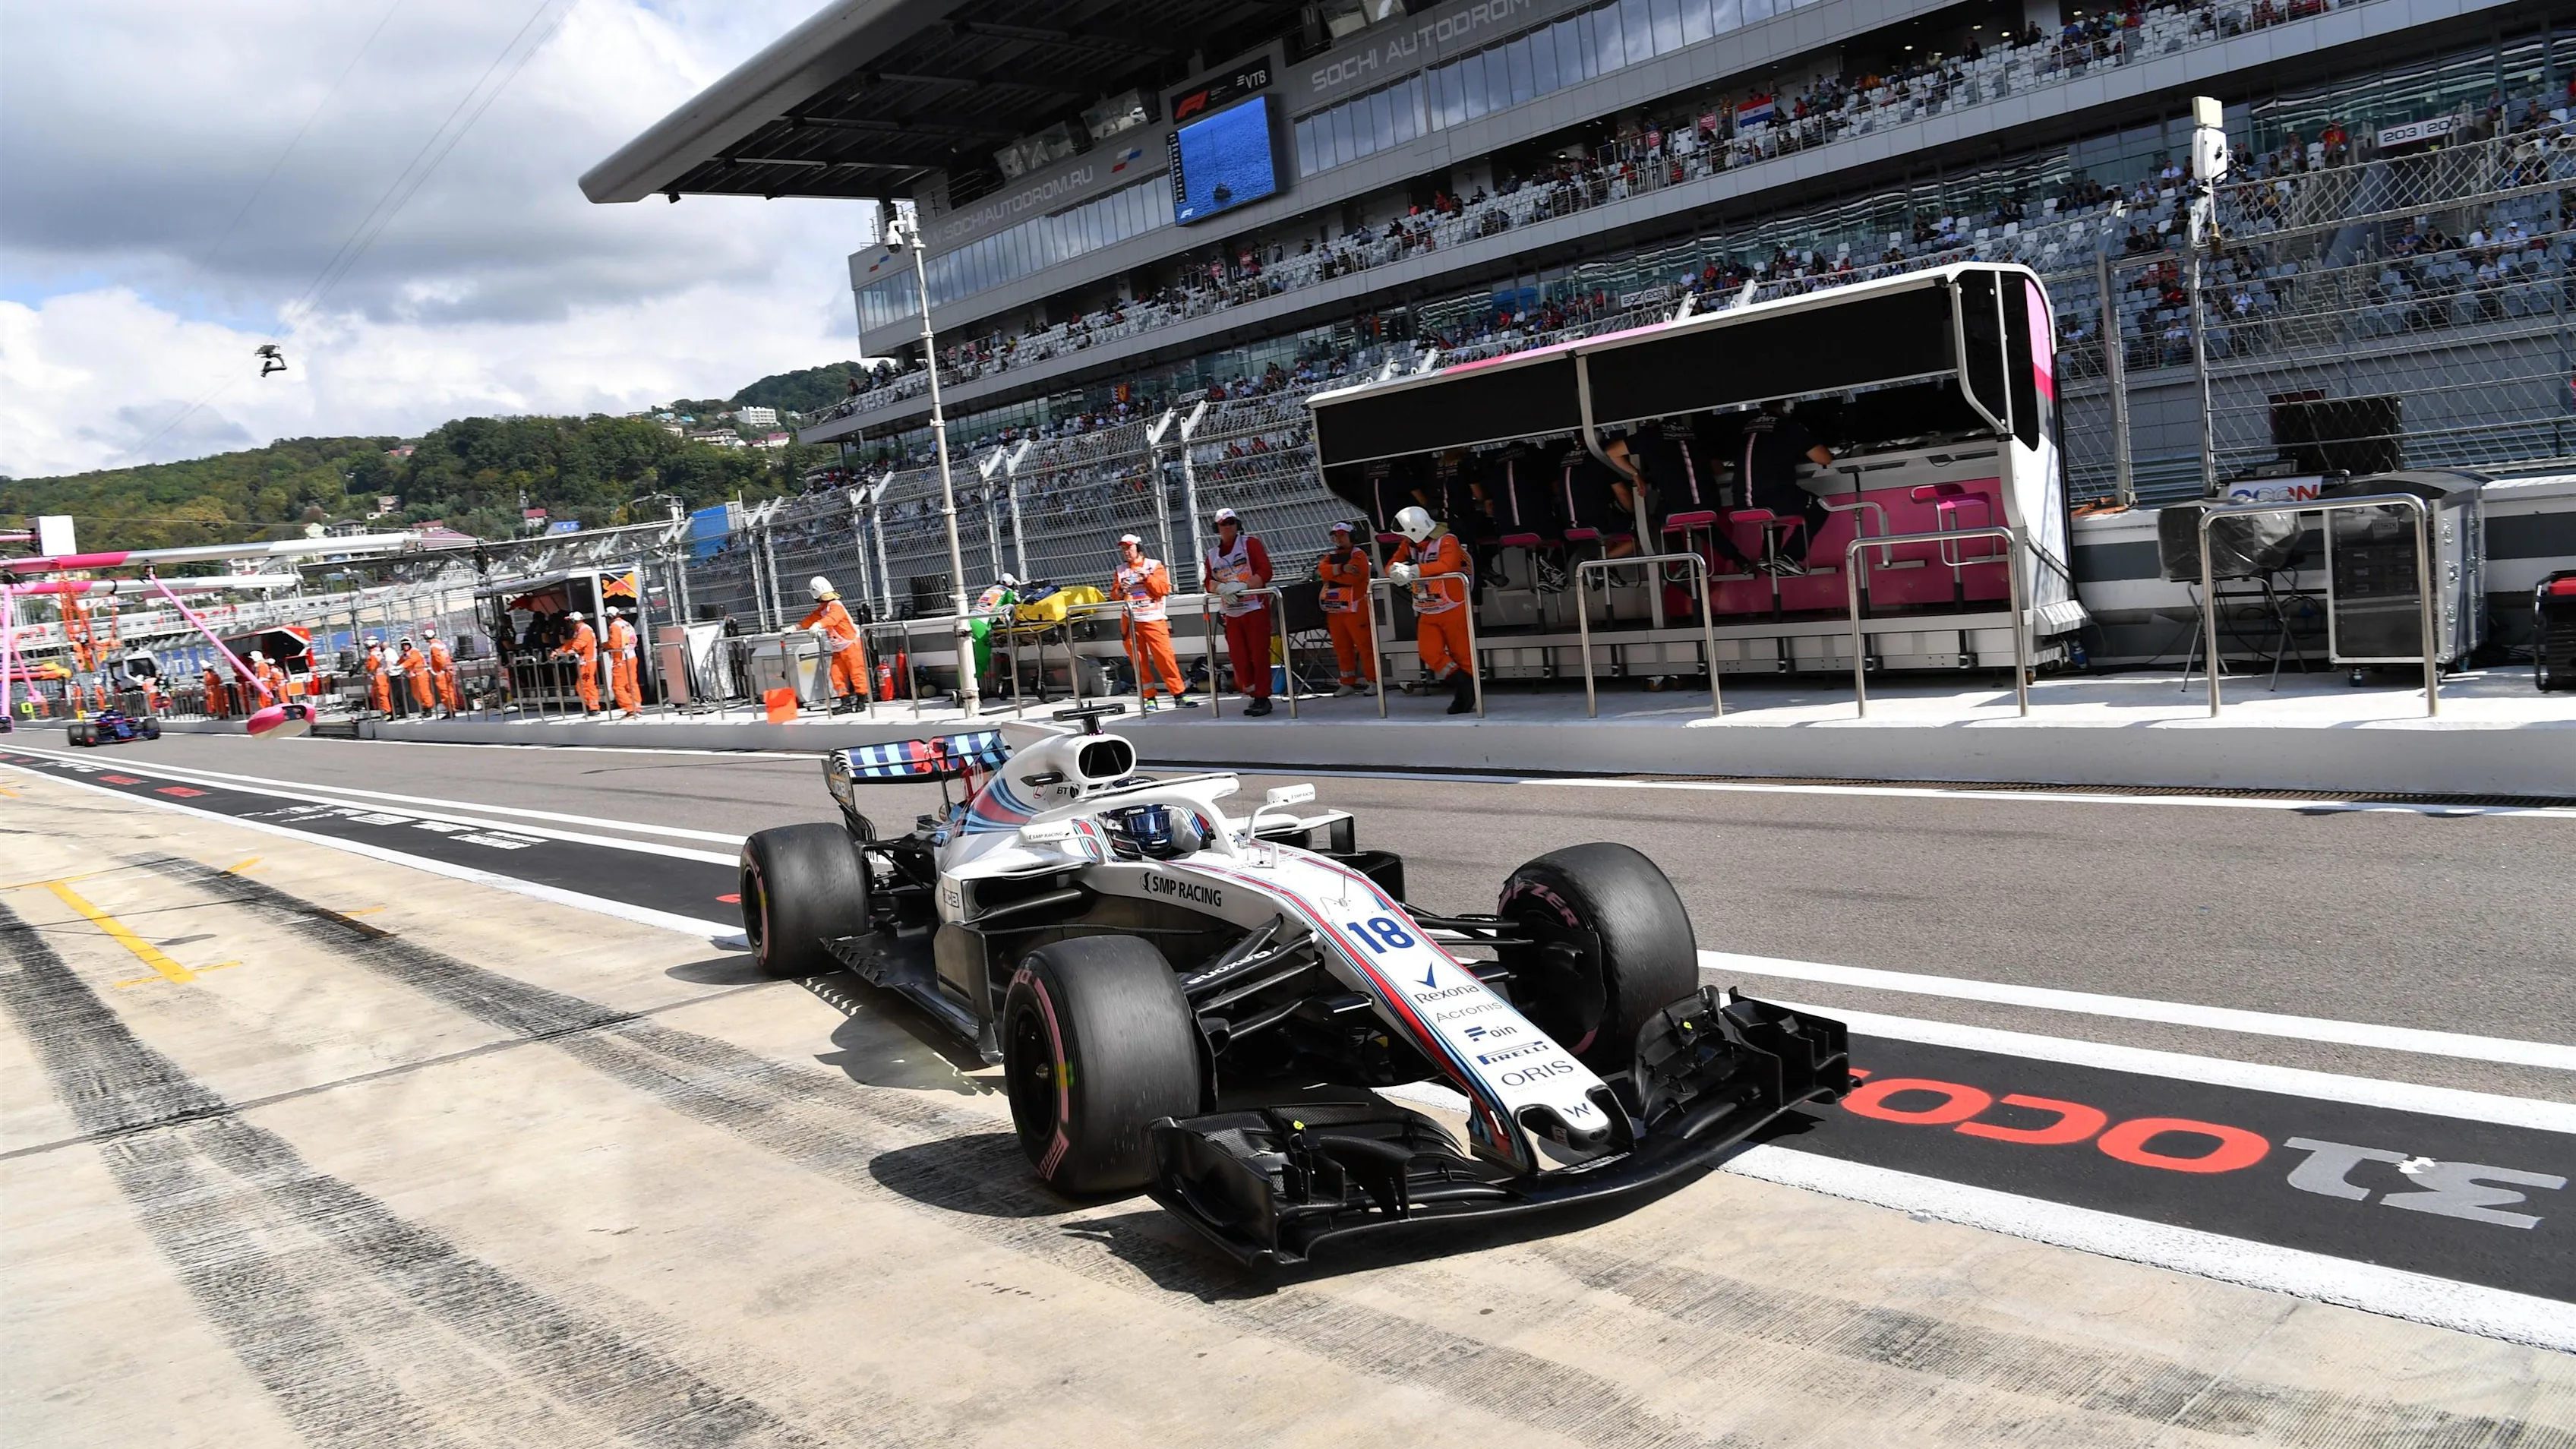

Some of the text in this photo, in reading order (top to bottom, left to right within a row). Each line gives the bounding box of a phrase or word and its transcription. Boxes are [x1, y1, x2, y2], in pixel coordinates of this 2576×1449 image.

[1312, 0, 1532, 93] SOCHI AUTODROM
[1245, 70, 1267, 89] VTB
[2382, 127, 2417, 143] 203
[1056, 786, 1069, 795] BT
[1152, 876, 1222, 907] SMP RACING
[1530, 882, 1580, 928] ZER
[1346, 917, 1416, 954] 18
[1413, 983, 1480, 1004] Rexona
[1435, 1000, 1503, 1023] Acronis
[1476, 1040, 1549, 1065] PIRELLI
[1501, 1060, 1574, 1086] ORIS
[1841, 1068, 2568, 1230] 31 OCO
